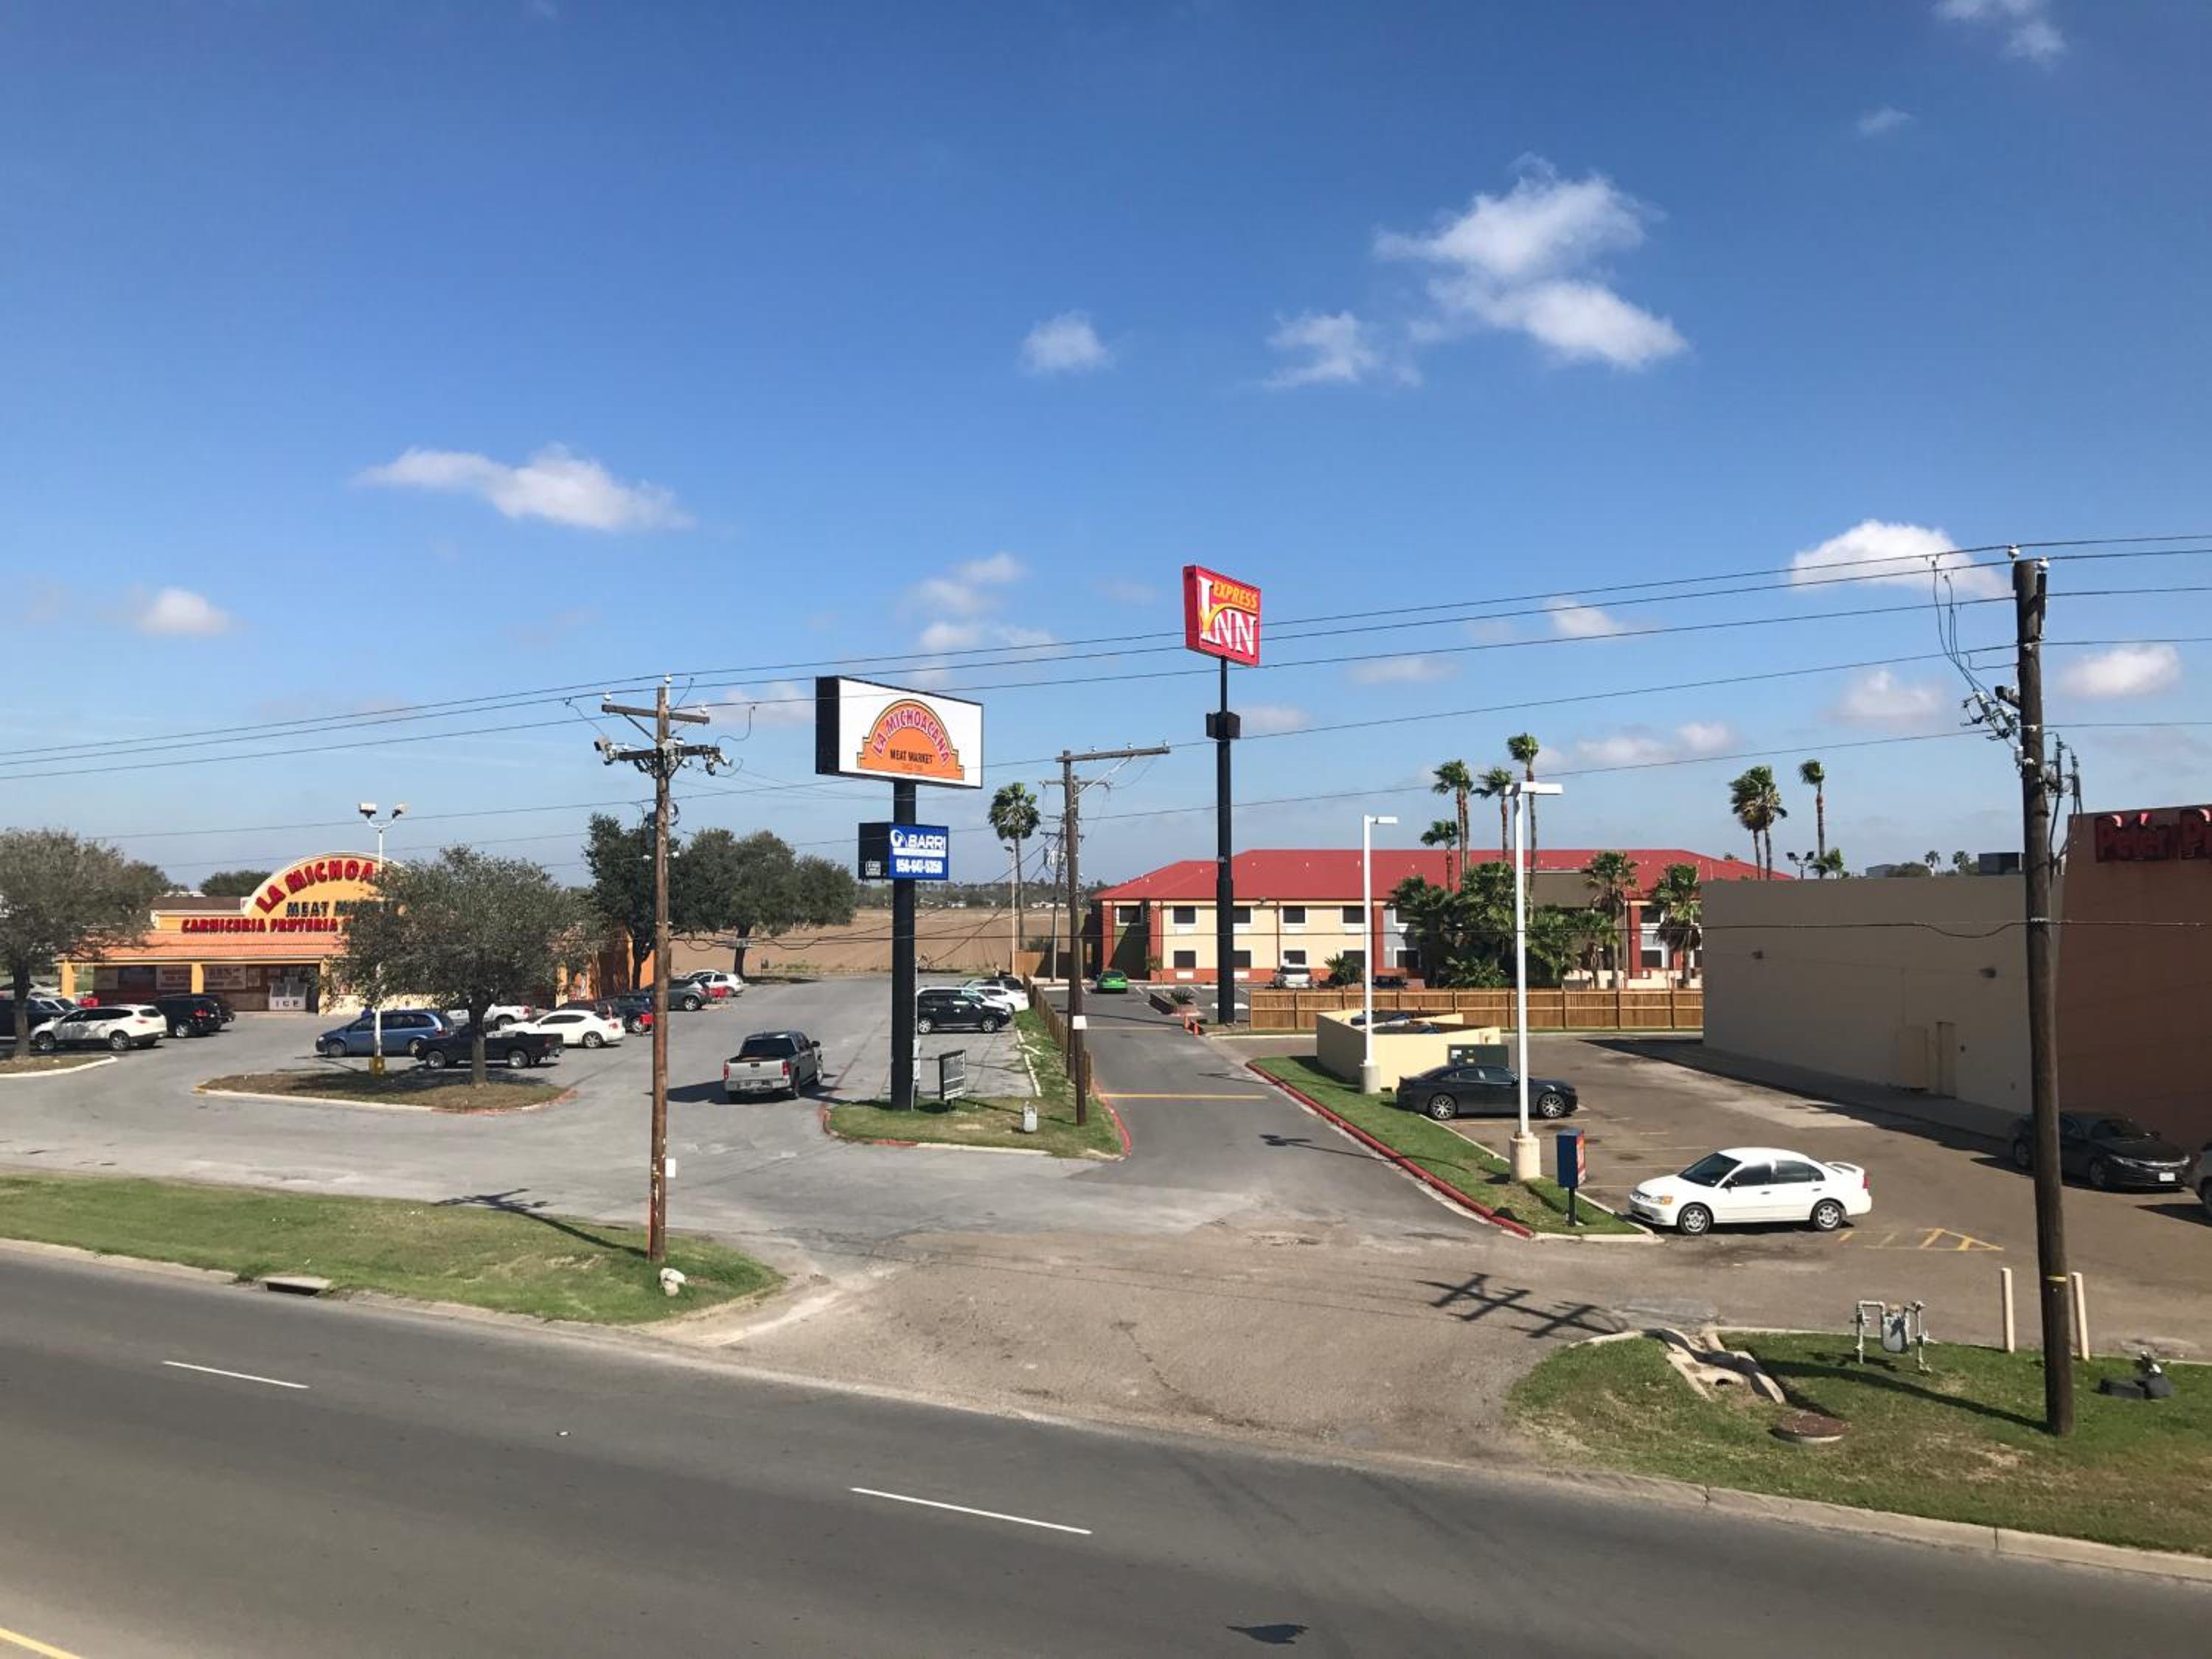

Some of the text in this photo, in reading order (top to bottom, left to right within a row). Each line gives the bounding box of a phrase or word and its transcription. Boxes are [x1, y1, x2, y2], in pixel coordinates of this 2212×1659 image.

[1213, 580, 1258, 609] EXPRESS
[1198, 576, 1257, 655] INN
[872, 708, 950, 765] LA MICHOACANA
[890, 748, 933, 765] MEAT MARKET
[908, 834, 947, 850] BARRI
[254, 859, 375, 915] LA MICHOA
[285, 901, 329, 917] MEAT
[181, 918, 266, 933] CARNICERIA
[269, 918, 338, 933] FRUTERIA
[276, 999, 302, 1008] ICE
